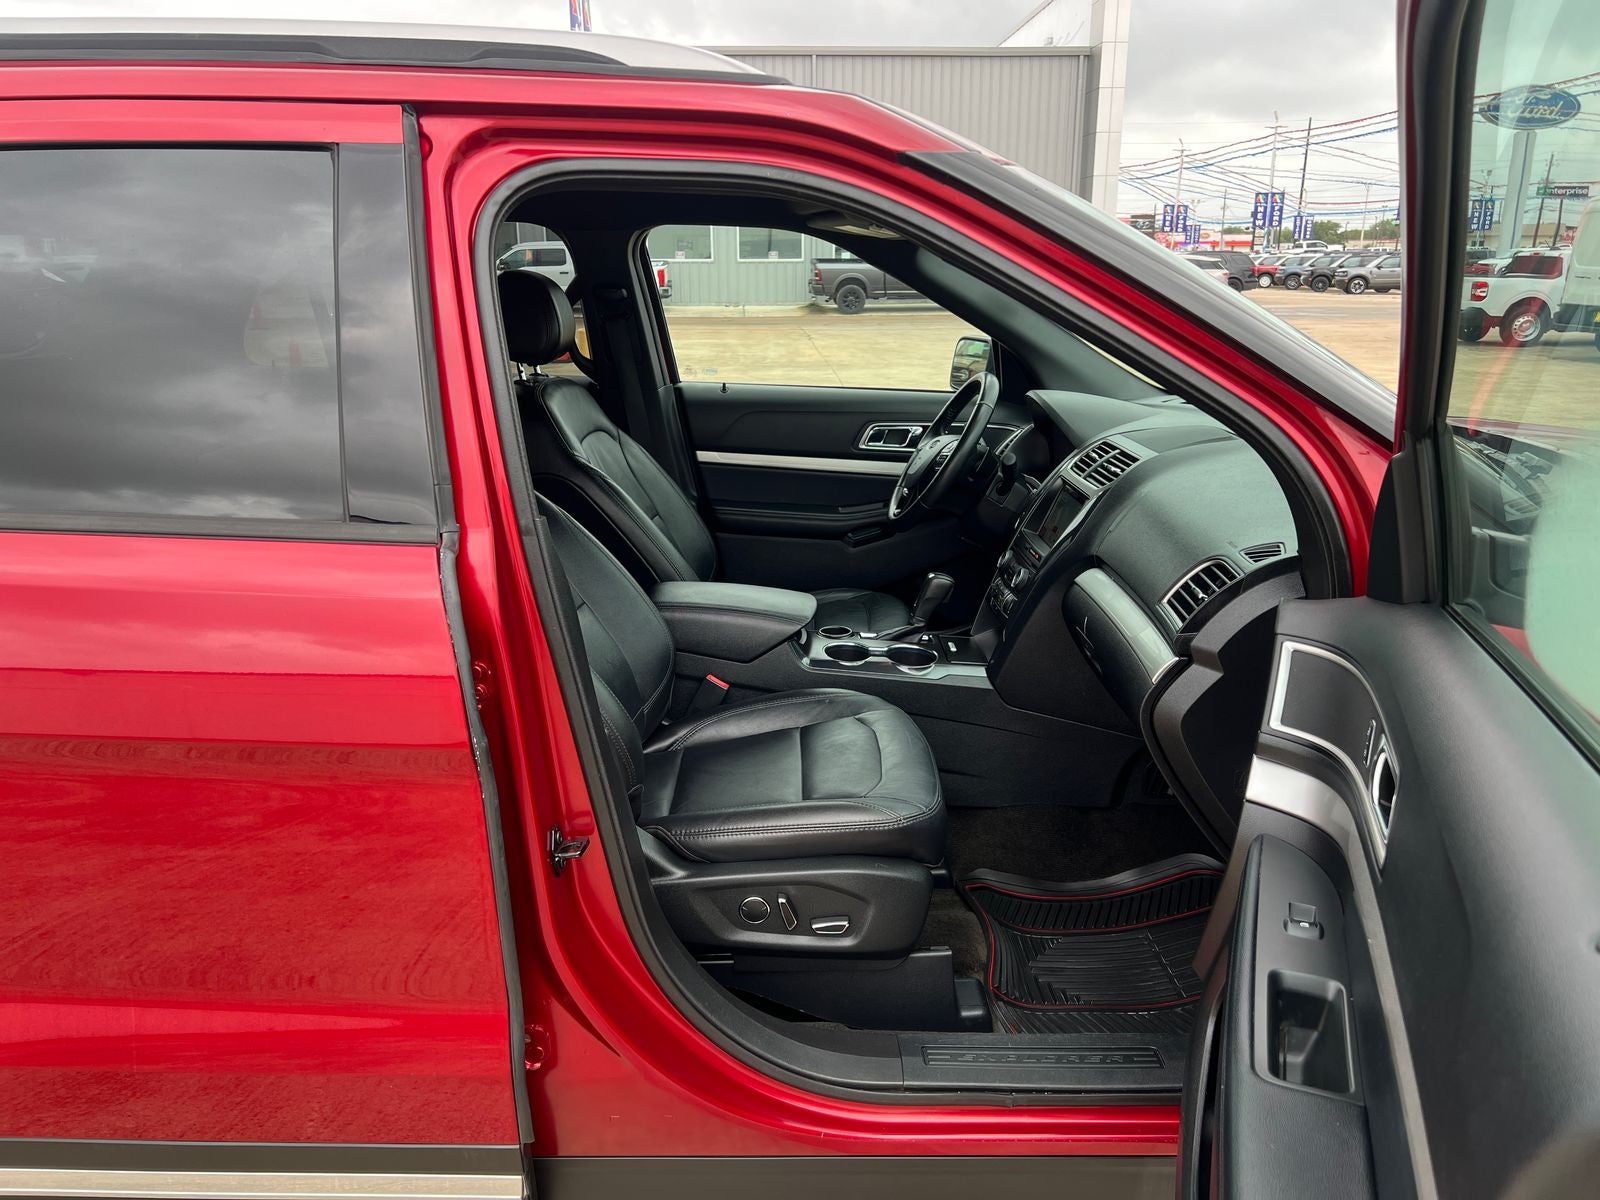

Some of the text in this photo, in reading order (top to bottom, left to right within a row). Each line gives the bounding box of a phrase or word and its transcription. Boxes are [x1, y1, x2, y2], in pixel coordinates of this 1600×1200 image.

[1163, 215, 1171, 232] NEW
[1255, 206, 1264, 226] NEW
[1272, 205, 1281, 226] FORD
[1471, 212, 1479, 230] NEW
